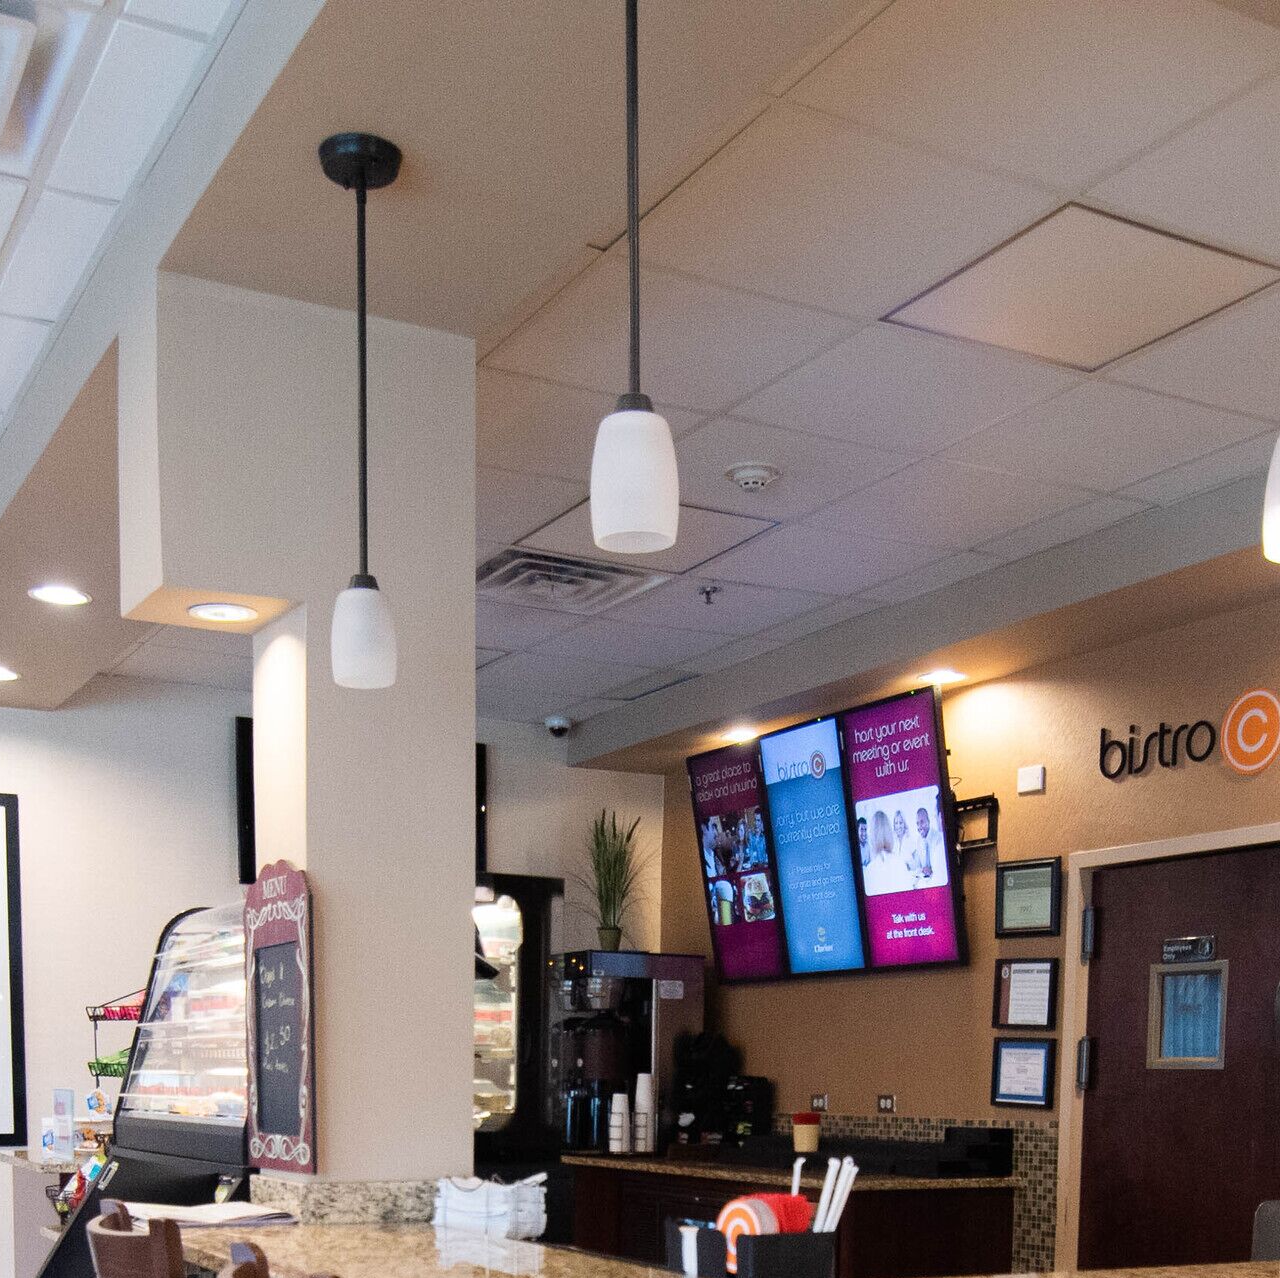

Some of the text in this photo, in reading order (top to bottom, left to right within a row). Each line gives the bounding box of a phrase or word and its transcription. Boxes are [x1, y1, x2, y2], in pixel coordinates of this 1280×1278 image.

[854, 715, 920, 744] host your next
[852, 732, 930, 764] meeting or event
[1100, 720, 1216, 779] bistro
[702, 769, 721, 789] great
[721, 764, 742, 783] place
[742, 761, 751, 774] to
[777, 760, 809, 781] bistro
[875, 759, 897, 778] with
[714, 783, 729, 799] and
[729, 777, 757, 794] unwind
[263, 876, 287, 900] MENU
[892, 912, 926, 924] Talk with us
[886, 930, 893, 940] at
[893, 929, 904, 938] the
[903, 927, 918, 938] front
[1163, 943, 1192, 953] Employees
[1163, 953, 1175, 961] Only
